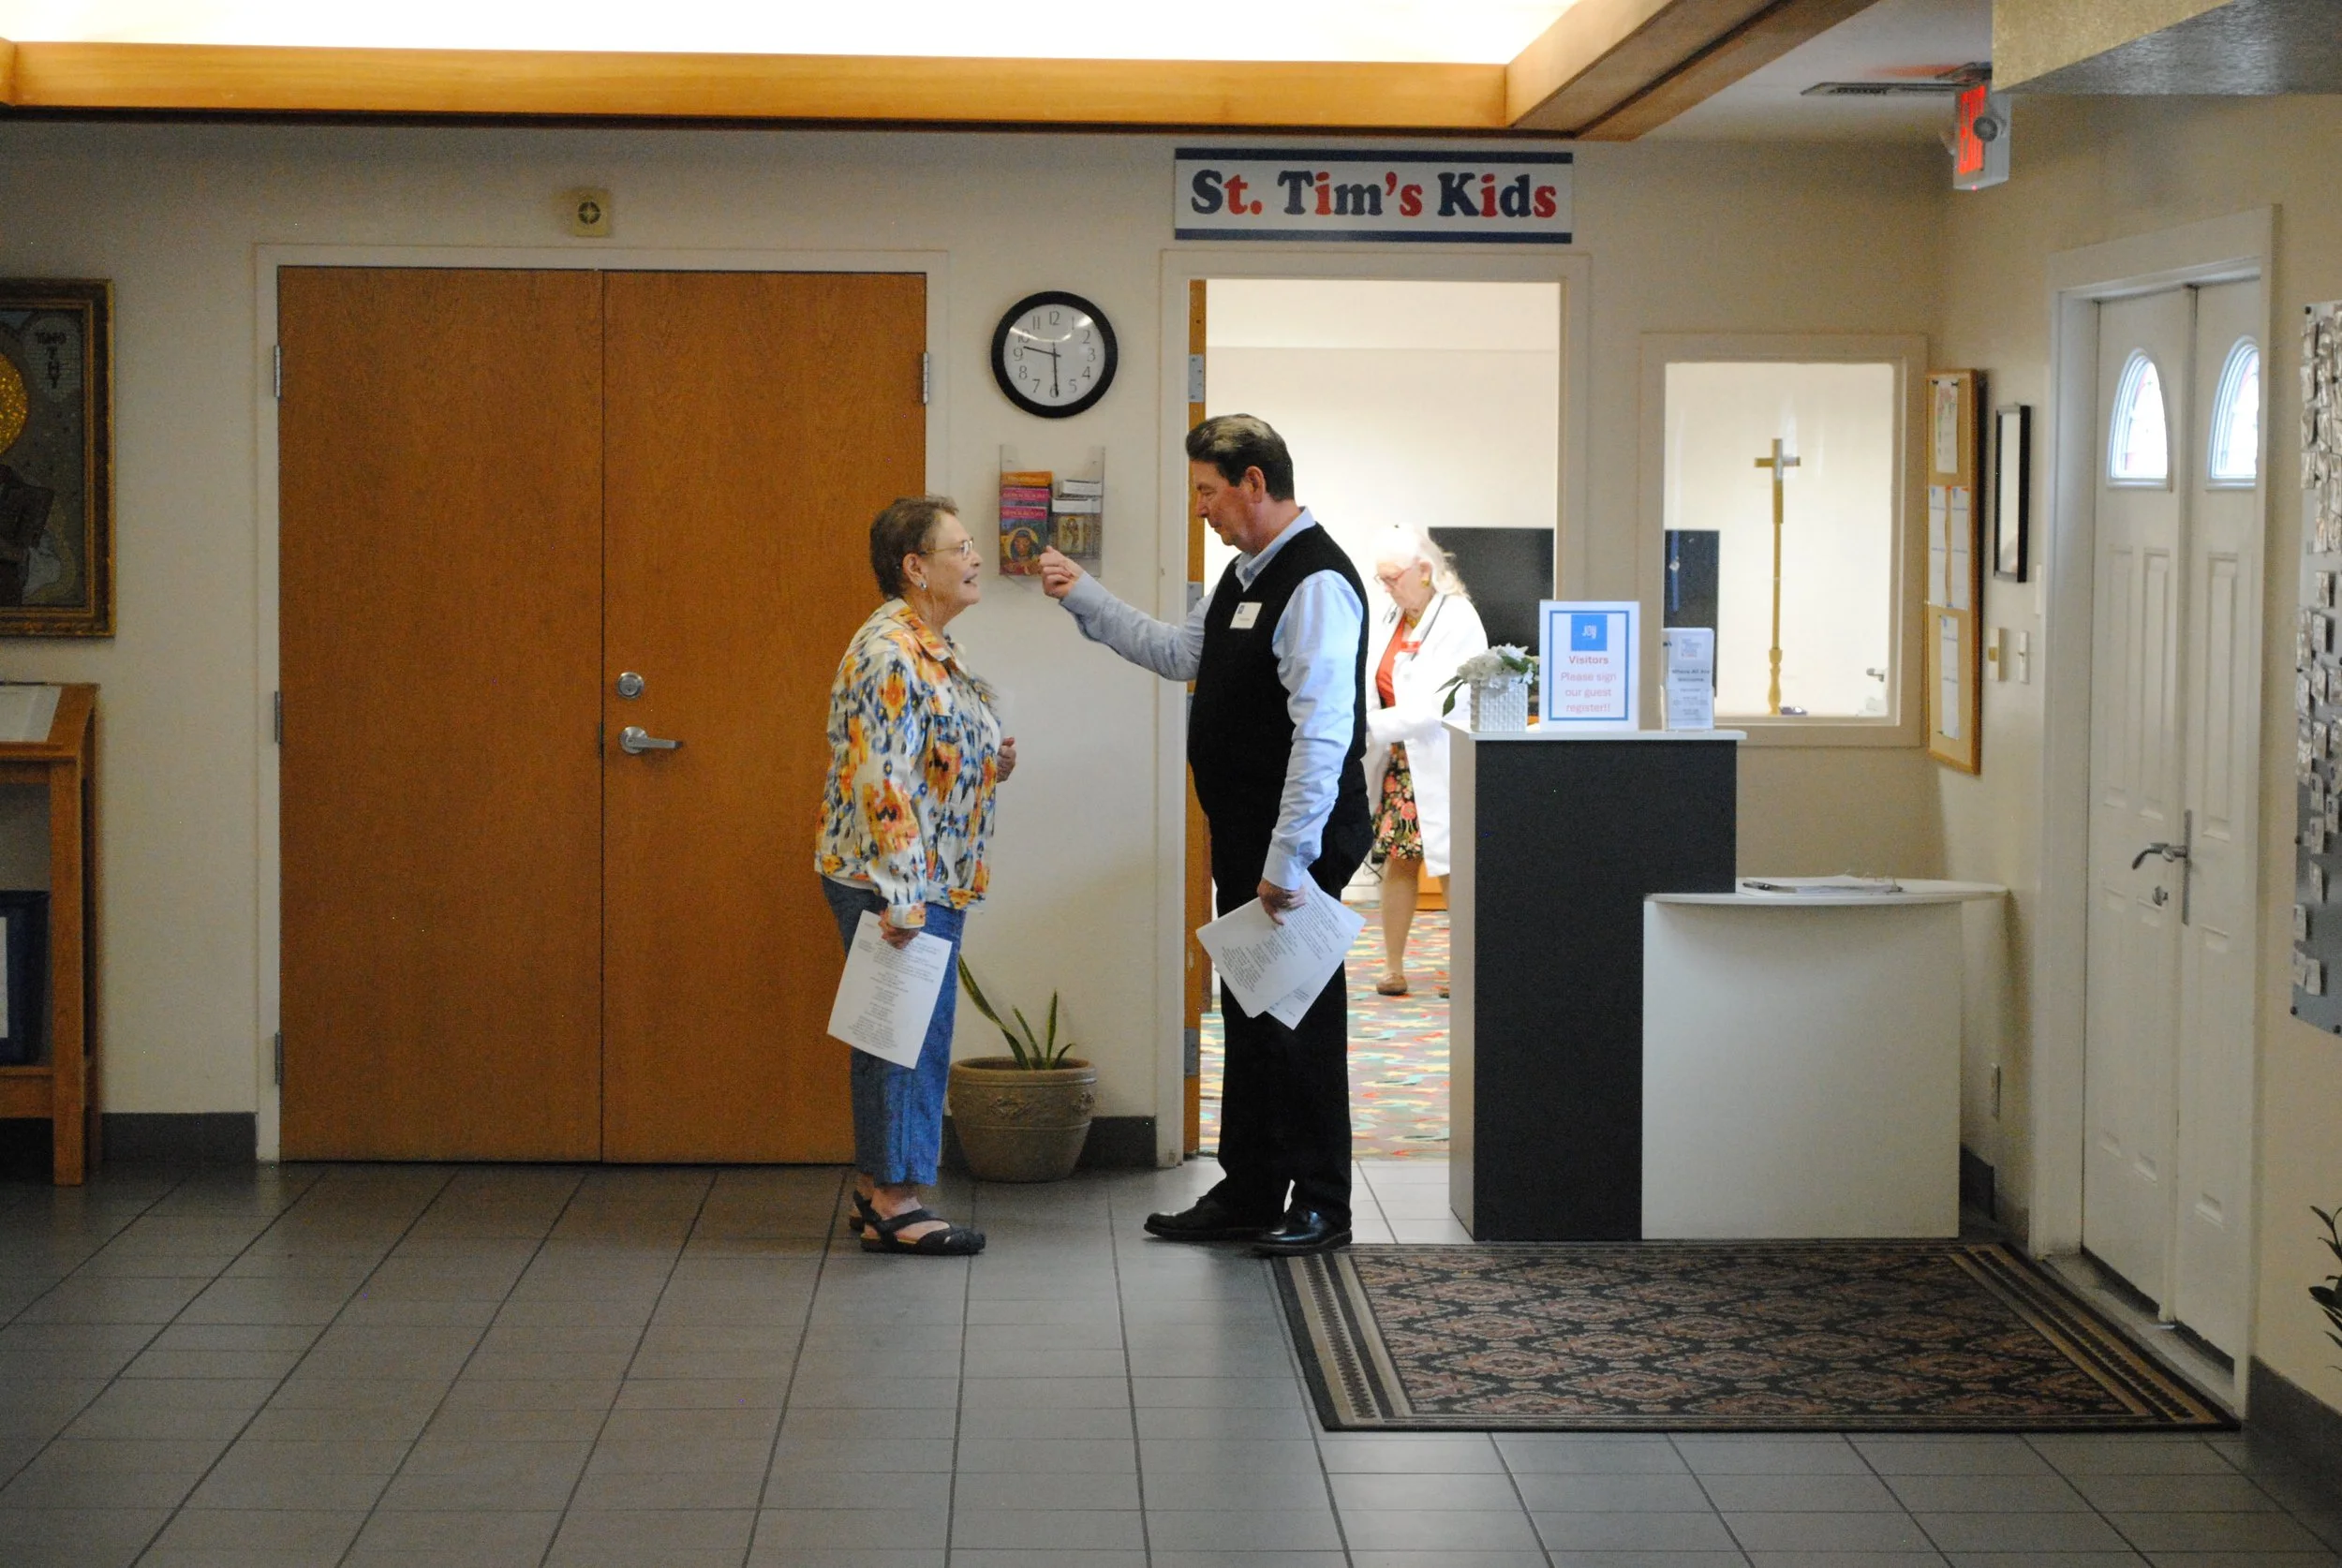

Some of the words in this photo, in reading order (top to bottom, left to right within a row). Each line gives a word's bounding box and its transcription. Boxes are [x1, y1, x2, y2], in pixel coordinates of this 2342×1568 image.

[1191, 169, 1263, 215] St.
[1277, 170, 1424, 217] Tim's
[1437, 172, 1557, 218] Kids
[1032, 316, 1041, 331] 11
[1048, 310, 1060, 326] 12
[1070, 315, 1075, 331] 1
[1082, 330, 1091, 345] 2
[1013, 348, 1023, 362] 9
[1087, 348, 1096, 362] 3
[1018, 365, 1028, 380] 8
[1081, 365, 1091, 379] 4
[1031, 378, 1041, 393] 7
[1069, 378, 1077, 393] 5
[1569, 656, 1609, 665] Visitors
[1561, 672, 1593, 682] Please
[1596, 672, 1617, 684] sign
[1564, 688, 1581, 697] our
[1584, 688, 1611, 699] guest
